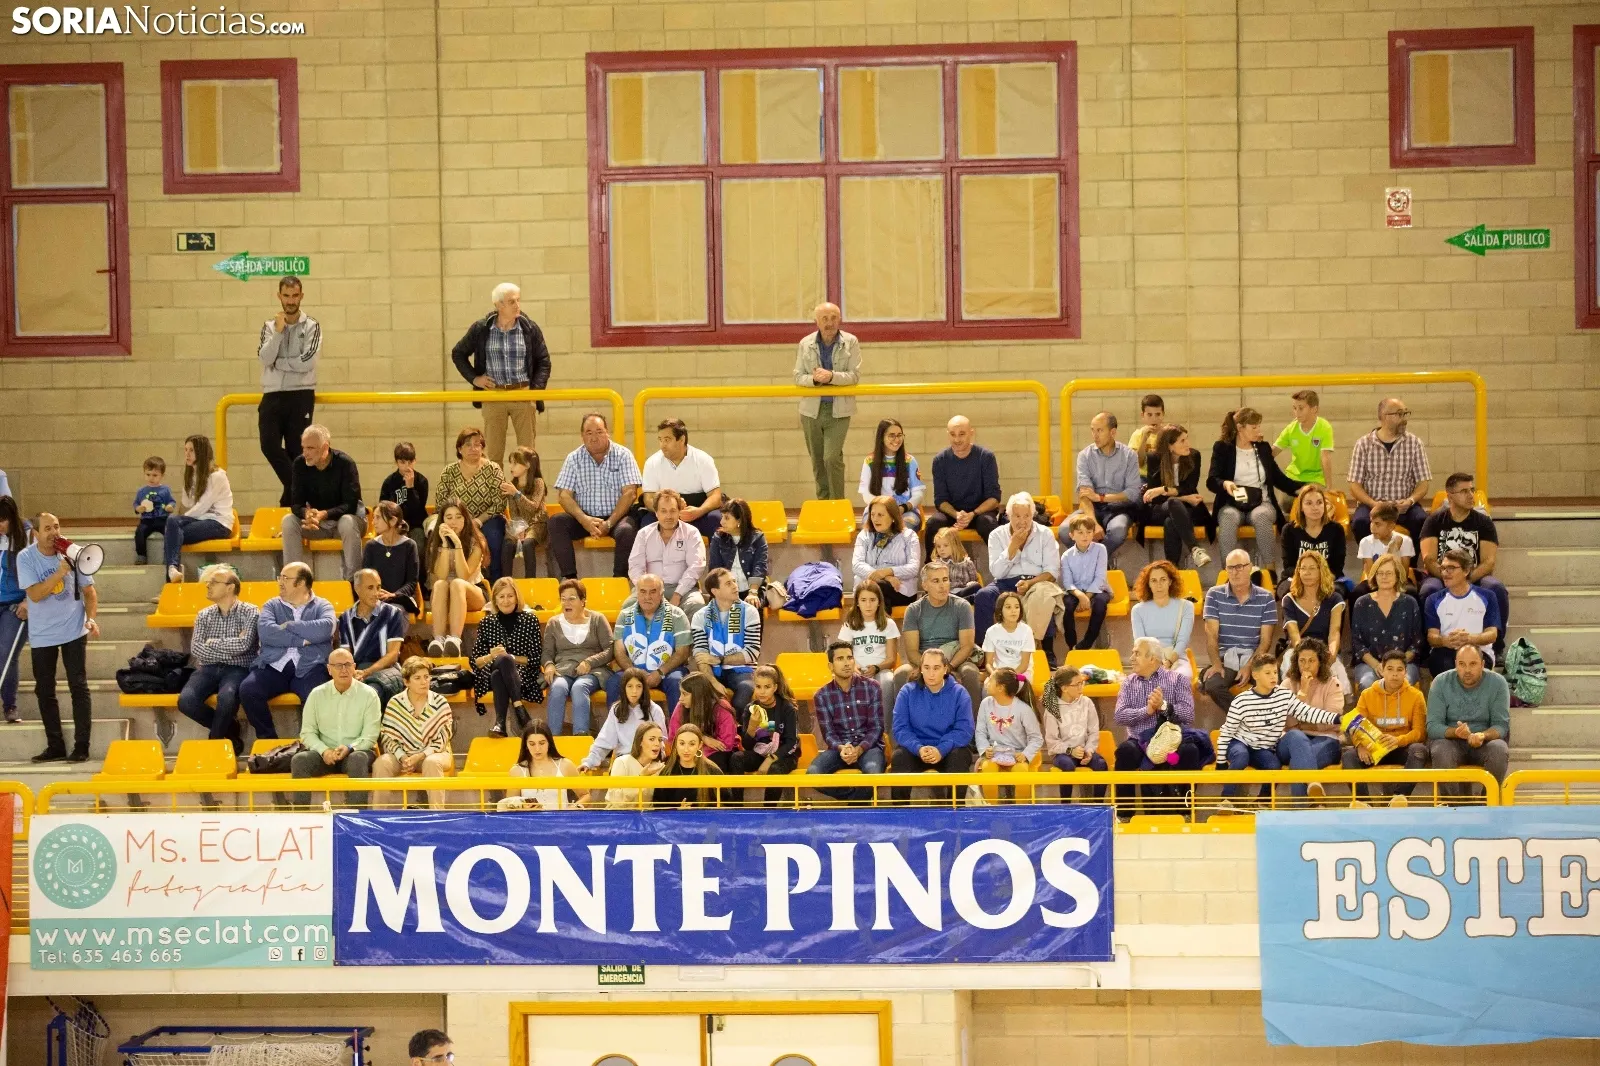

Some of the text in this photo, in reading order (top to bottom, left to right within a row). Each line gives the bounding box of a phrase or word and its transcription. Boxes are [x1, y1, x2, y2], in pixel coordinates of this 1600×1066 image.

[1464, 232, 1545, 247] SALIDA PUBLICO
[229, 259, 306, 273] SALIDA PUBLICO
[1300, 540, 1329, 549] YOU ARE
[728, 607, 741, 634] SORIA
[126, 828, 188, 864] Ms.
[126, 867, 325, 912] fotografía
[347, 837, 1100, 935] MONTE PINOS
[34, 919, 329, 946] www.mseclat.com
[38, 946, 183, 964] Tel: 635 463 665
[599, 973, 644, 983] EMERGENCIA
[601, 965, 628, 973] SALIDA
